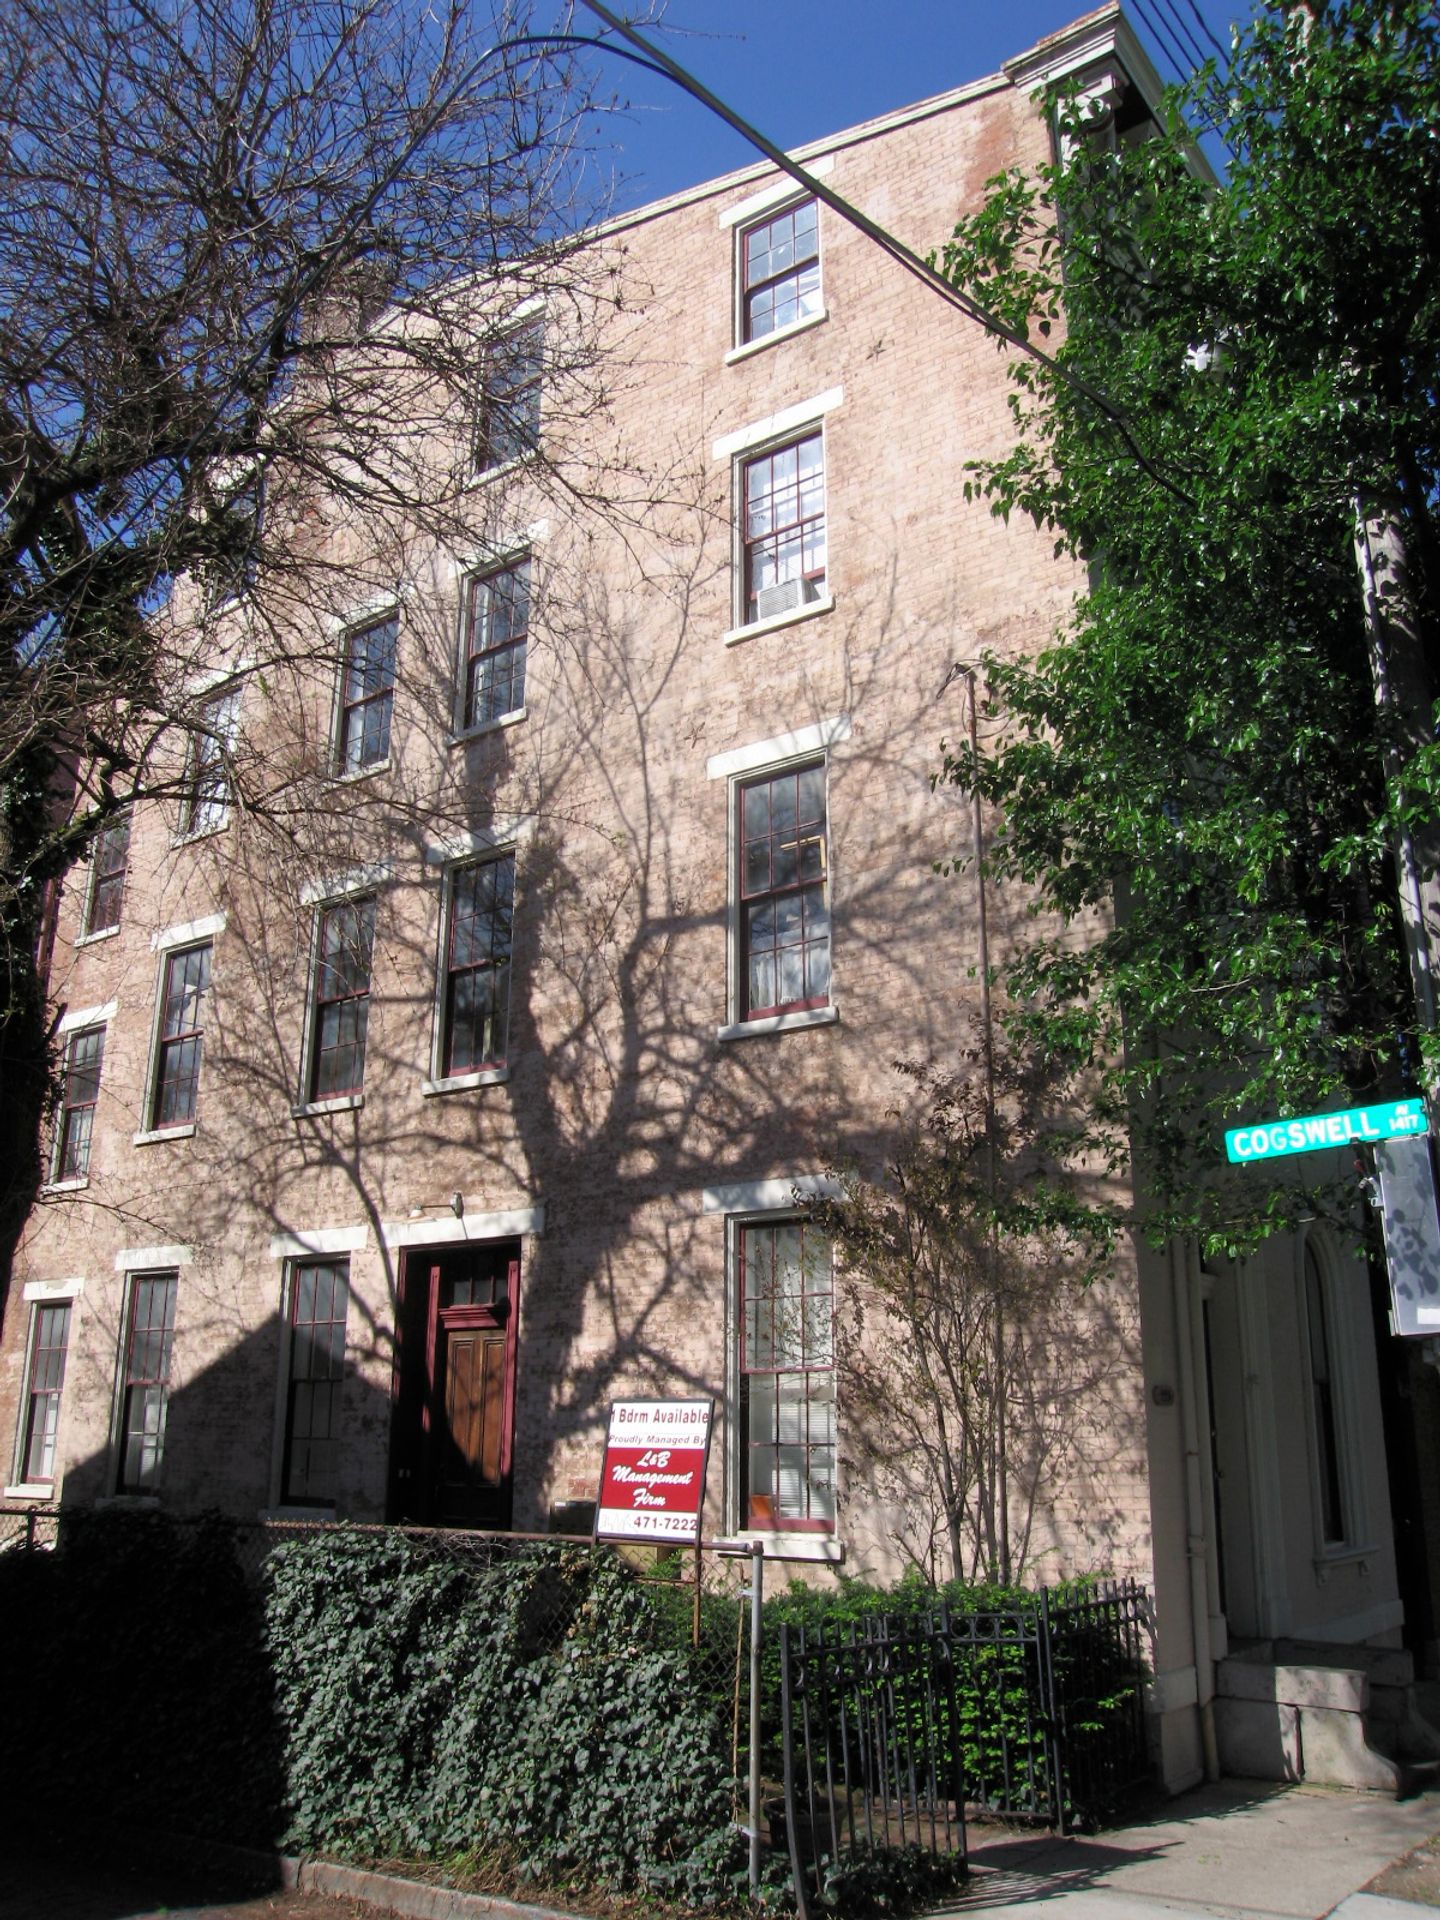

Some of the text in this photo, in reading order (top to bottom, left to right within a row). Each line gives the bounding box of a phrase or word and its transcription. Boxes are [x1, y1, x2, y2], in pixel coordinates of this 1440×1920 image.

[1233, 1111, 1380, 1156] COGSWELL
[619, 1408, 648, 1423] Bdrm
[653, 1409, 709, 1424] Available
[609, 1434, 706, 1446] Proudly Managed By
[636, 1450, 671, 1468] L&B
[612, 1465, 693, 1488] Management
[633, 1487, 666, 1507] Firm
[633, 1516, 697, 1531] 471-7222
